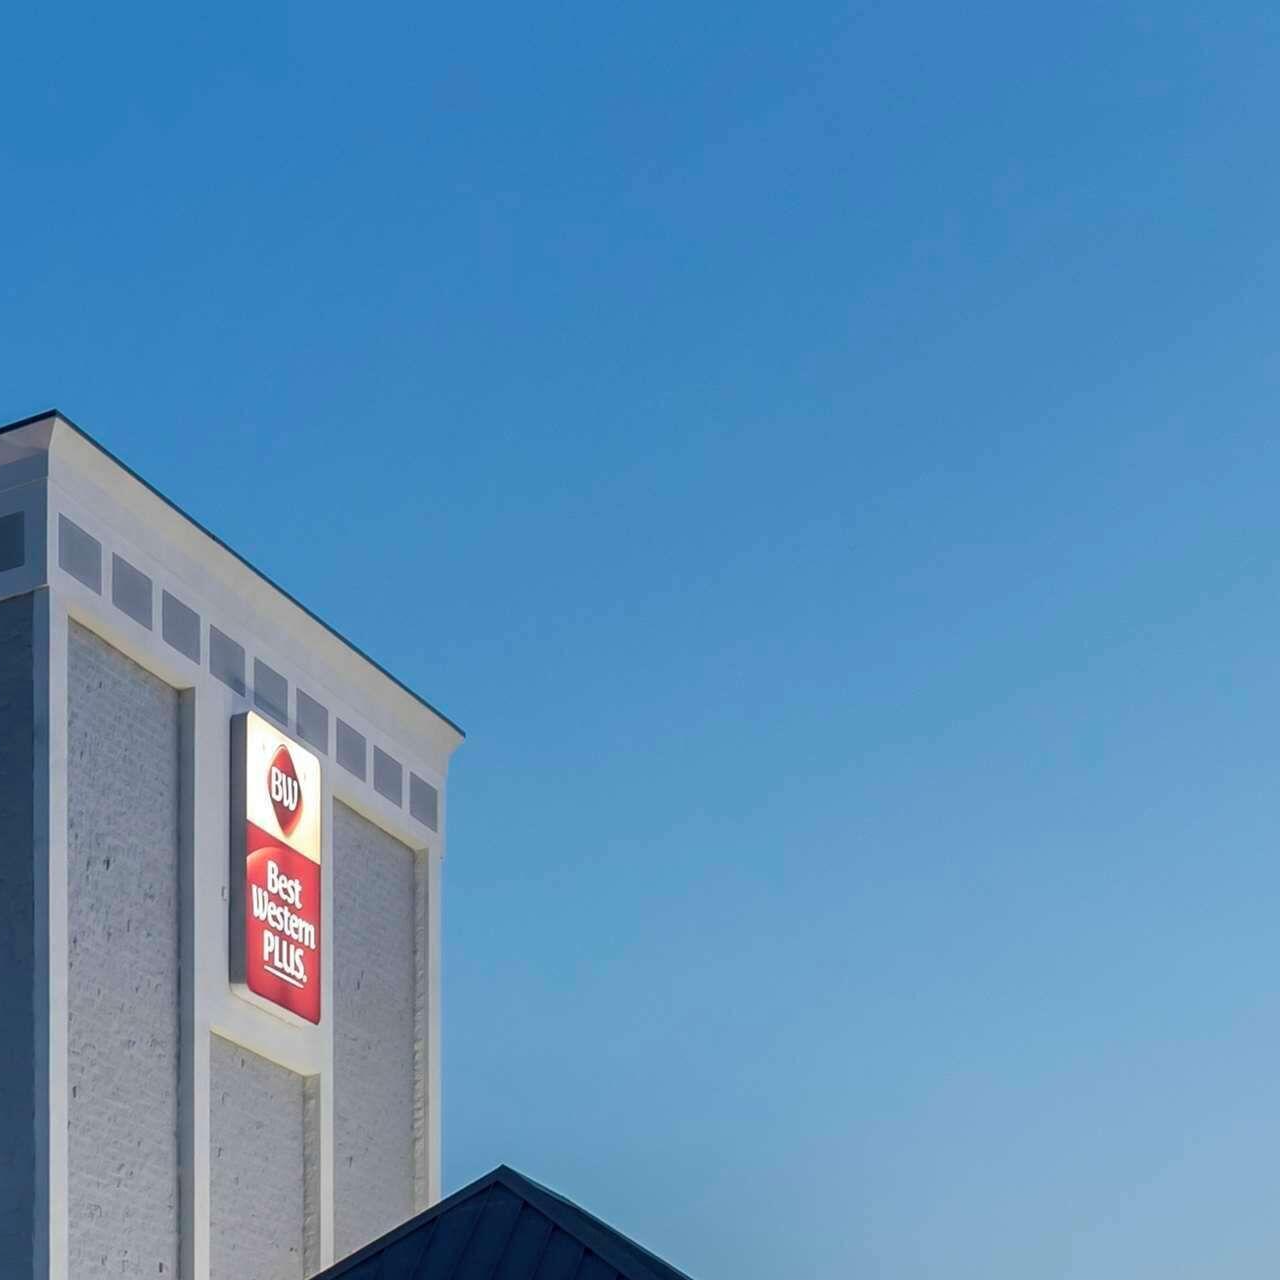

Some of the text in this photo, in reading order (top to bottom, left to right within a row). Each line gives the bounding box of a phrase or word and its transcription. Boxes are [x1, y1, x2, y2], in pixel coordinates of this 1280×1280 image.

[271, 766, 298, 811] BW
[267, 860, 302, 909] Best
[251, 884, 316, 950] Western
